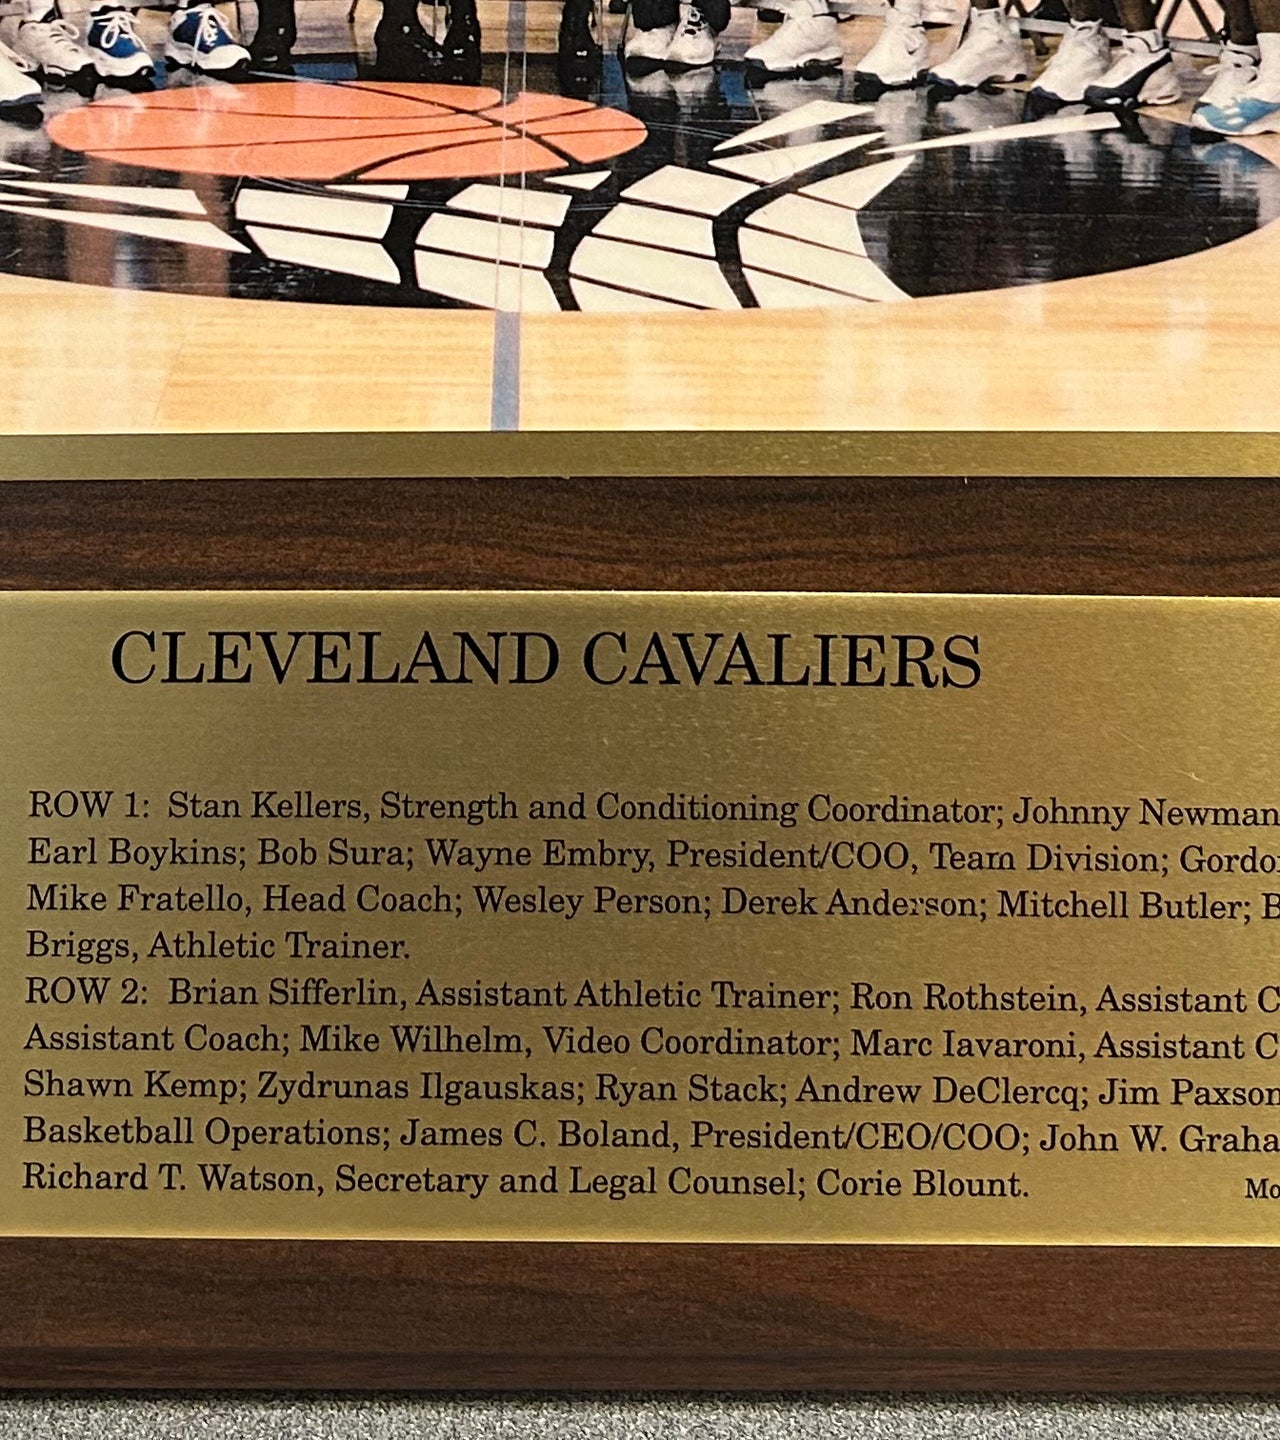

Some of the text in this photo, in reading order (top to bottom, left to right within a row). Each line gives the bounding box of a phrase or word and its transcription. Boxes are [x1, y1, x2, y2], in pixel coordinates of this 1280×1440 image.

[111, 630, 981, 689] CLEVELAND CAVALIERS
[28, 789, 115, 818] ROW
[124, 791, 149, 819] 1:
[168, 790, 242, 819] Stan
[250, 790, 370, 824] Kellers,
[380, 790, 519, 826] Strength
[528, 791, 587, 820] and
[596, 791, 800, 828] Conditioning
[807, 793, 1004, 830] Coordinator;
[1012, 796, 1131, 832] Johnny
[27, 836, 98, 865] Earl
[107, 837, 246, 872] Boykins;
[257, 837, 317, 866] Bob
[328, 837, 414, 872] Sura;
[424, 838, 532, 873] Wayne
[542, 838, 655, 874] Embry,
[666, 839, 918, 876] President/COO,
[929, 842, 1017, 871] Team
[1026, 843, 1169, 878] Division;
[26, 883, 107, 912] Mike
[117, 883, 252, 918] Fratello,
[262, 884, 346, 913] Head
[356, 884, 462, 918] Coach;
[472, 885, 585, 920] Wesley
[593, 885, 711, 921] Person;
[721, 887, 819, 916] Derek
[824, 887, 987, 923] Anderson;
[996, 889, 1129, 919] Mitchell
[1138, 891, 1251, 926] Butler;
[26, 929, 410, 965] Briggs, Athletic Trainer.
[24, 976, 112, 1005] ROW
[120, 977, 147, 1005] 2:
[168, 977, 259, 1005] Brian
[269, 977, 407, 1011] Sifferlin,
[414, 978, 568, 1007] Assistant
[573, 979, 702, 1008] Athletic
[710, 980, 840, 1015] Trainer;
[849, 982, 913, 1010] Ron
[923, 982, 1087, 1018] Rothstein,
[1095, 984, 1248, 1014] Assistant
[23, 1022, 175, 1052] Assistant
[184, 1023, 289, 1058] Coach;
[299, 1024, 380, 1053] Mike
[389, 1024, 532, 1059] Wilhelm,
[542, 1025, 631, 1054] Video
[640, 1026, 840, 1062] Coordinator;
[850, 1028, 933, 1057] Marc
[942, 1029, 1086, 1064] Iavaroni,
[1092, 1030, 1246, 1060] Assistant
[24, 1068, 134, 1097] Shawn
[143, 1069, 247, 1105] Kemp;
[257, 1070, 409, 1105] Zydrunas
[419, 1071, 584, 1107] Ilgauskas;
[594, 1073, 678, 1108] Ryan
[688, 1073, 787, 1109] Stack;
[794, 1074, 923, 1104] Andrew
[932, 1076, 1089, 1113] DeClercq;
[1098, 1077, 1161, 1106] Jim
[22, 1115, 195, 1145] Basketball
[205, 1116, 390, 1152] Operations;
[399, 1118, 503, 1147] James
[513, 1119, 546, 1148] C.
[557, 1119, 679, 1154] Boland,
[690, 1120, 1030, 1157] President/CEO/COO;
[1039, 1123, 1120, 1152] John
[1128, 1124, 1167, 1153] W.
[22, 1161, 1029, 1202] Richard T. Watson, Secretary and Legal Counsel; Corie Blount.
